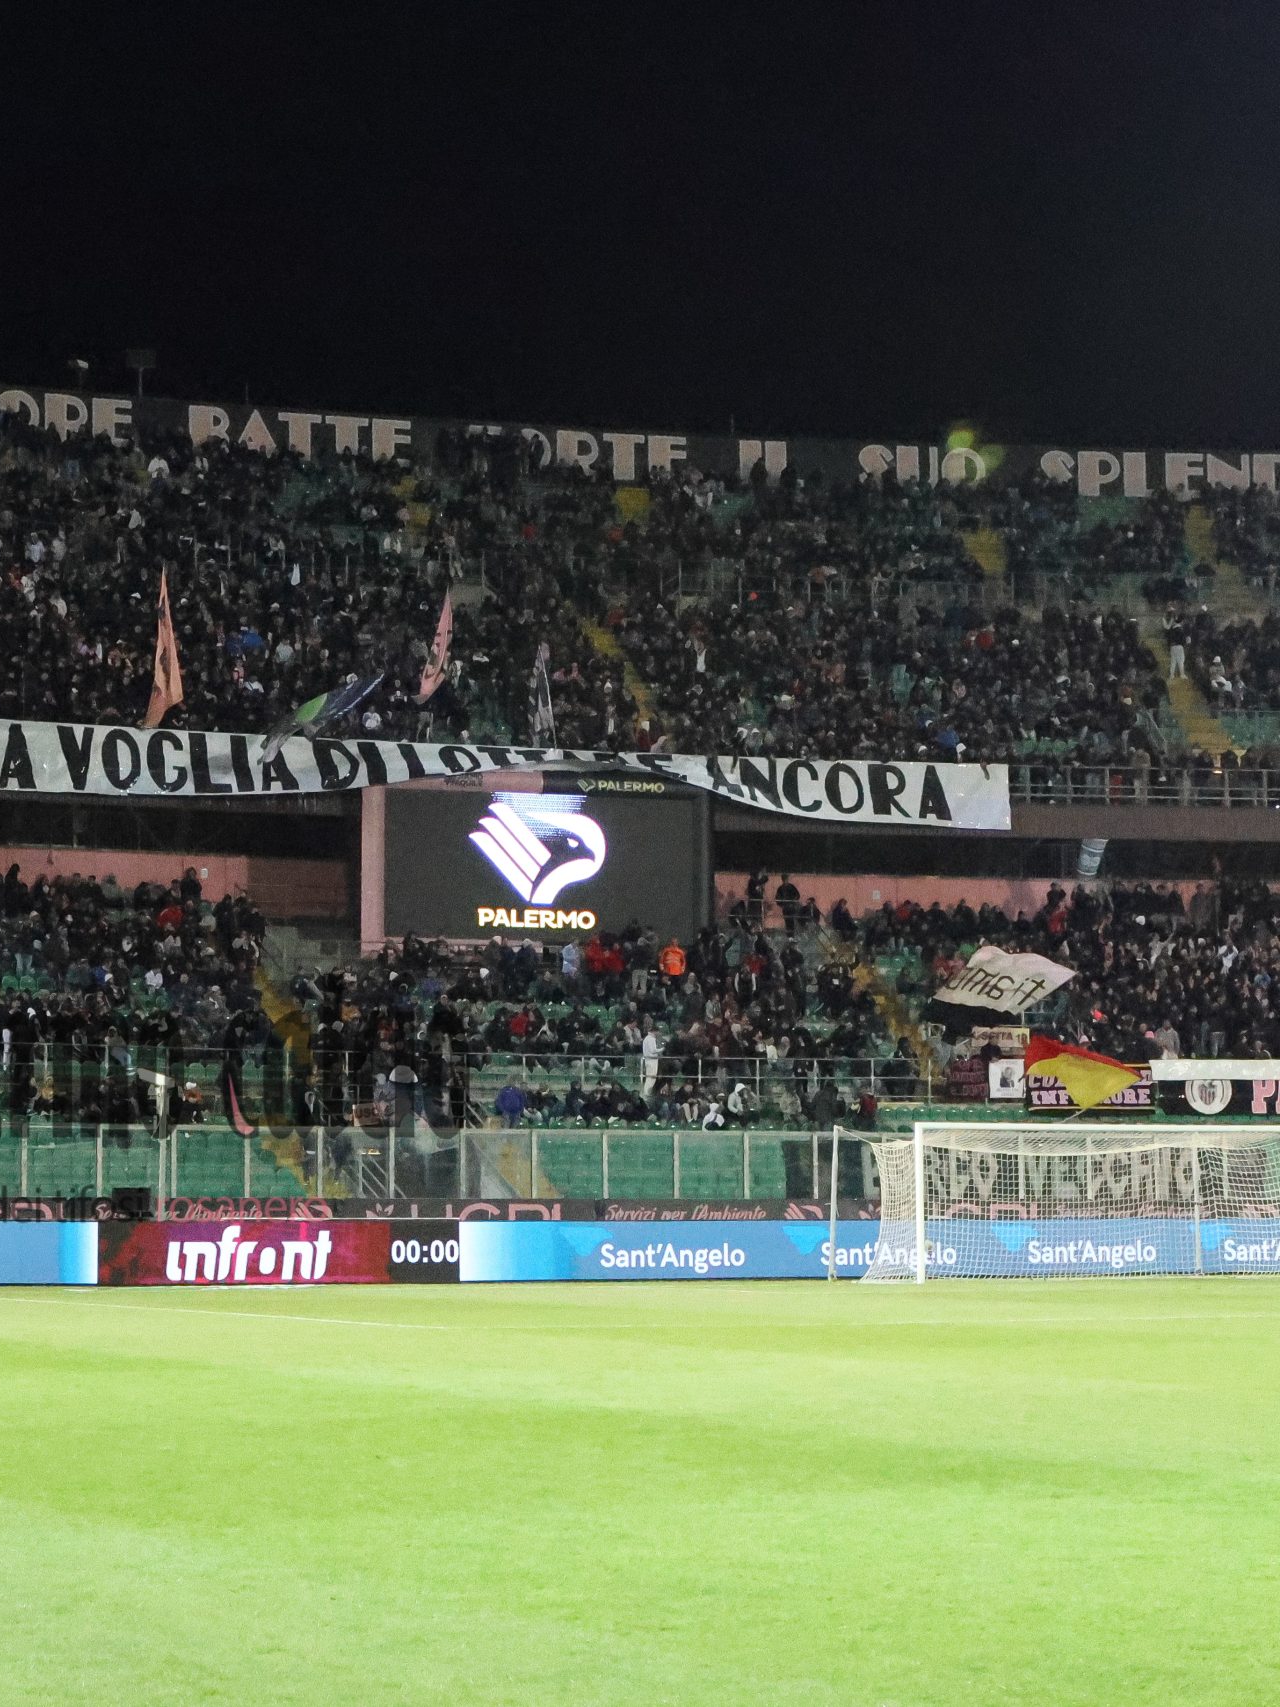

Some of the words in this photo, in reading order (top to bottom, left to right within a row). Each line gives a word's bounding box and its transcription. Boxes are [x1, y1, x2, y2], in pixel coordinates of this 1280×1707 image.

[56, 725, 300, 795] VOGLIA
[311, 737, 391, 791] DI
[709, 756, 952, 820] ANCORA
[597, 781, 666, 794] PALERMO
[477, 907, 597, 931] PALERMO
[604, 1203, 657, 1221] Servizi
[391, 1239, 460, 1264] 00:00
[600, 1241, 746, 1273] Sant'Angelo
[819, 1240, 957, 1273] Sant'Angelo
[1028, 1239, 1157, 1269] Sant'Angelo
